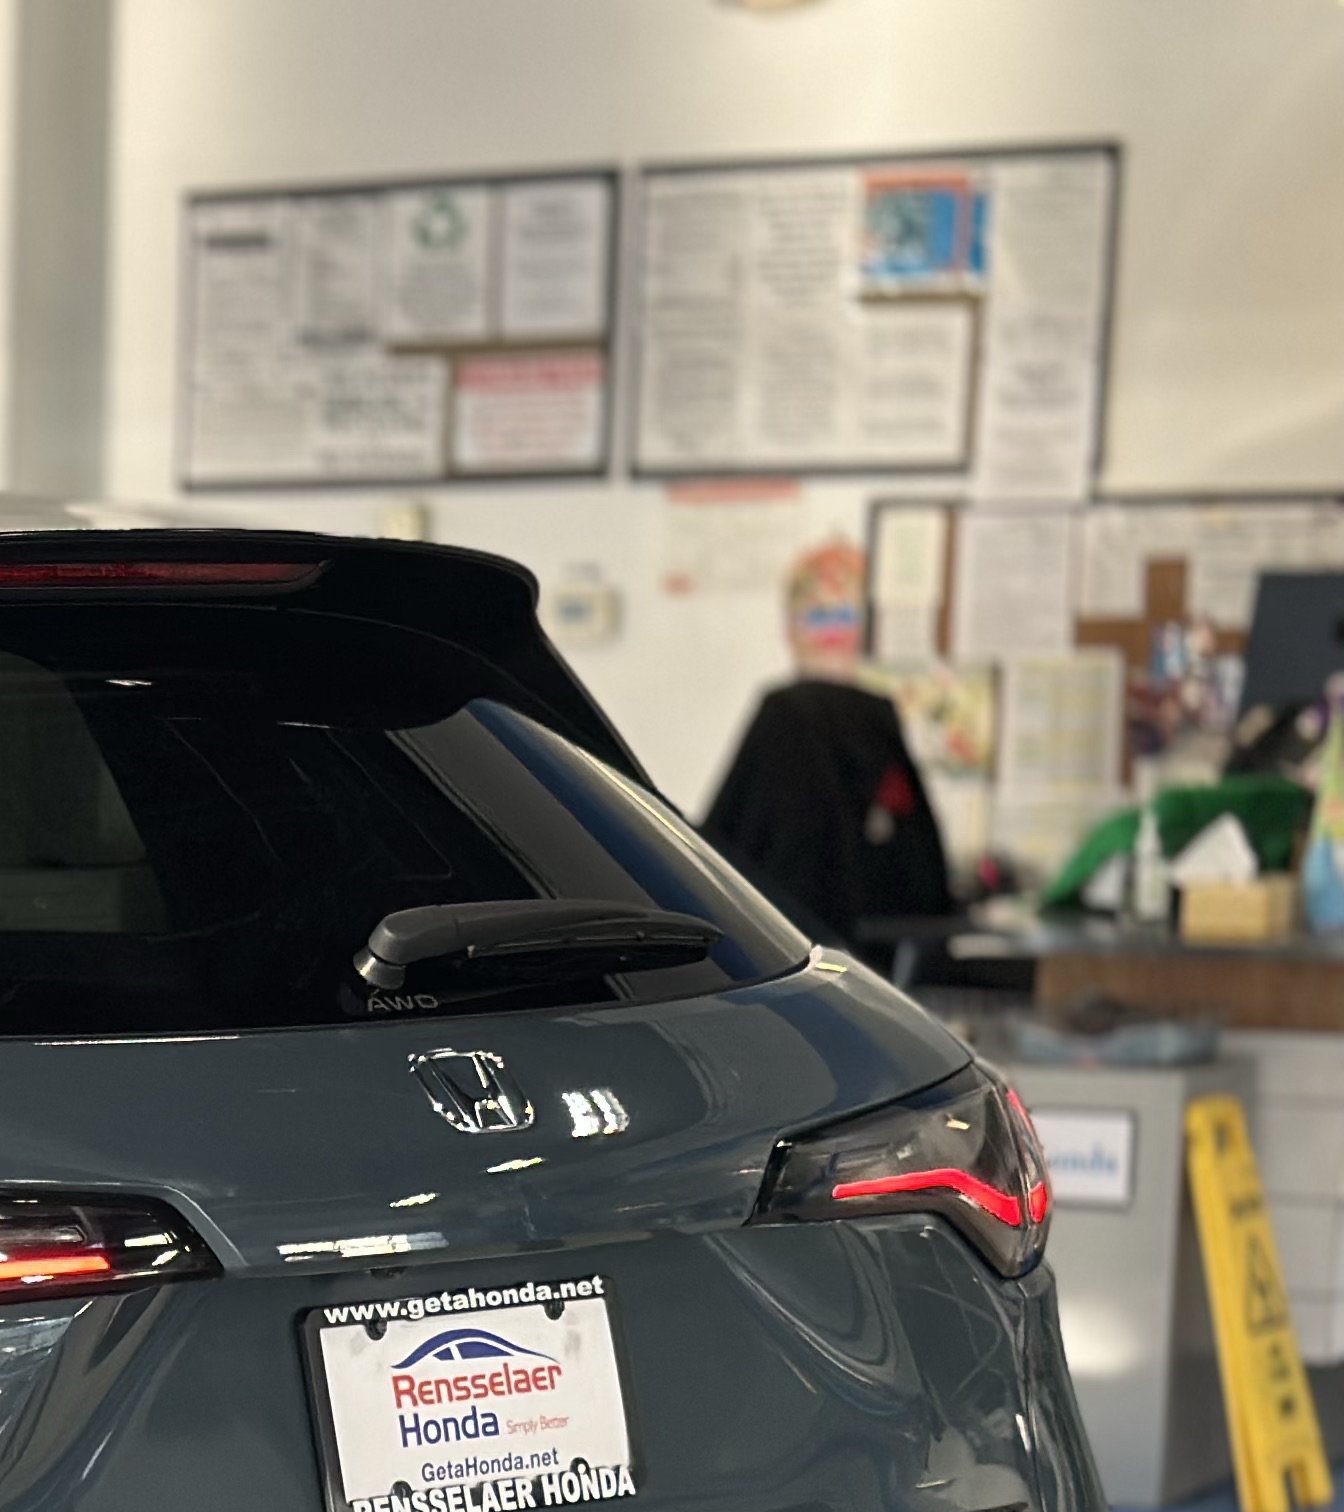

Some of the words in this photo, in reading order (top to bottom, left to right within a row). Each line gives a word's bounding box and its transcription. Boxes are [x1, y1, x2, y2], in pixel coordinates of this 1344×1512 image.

[324, 1276, 604, 1324] www.getahonda.net
[391, 1362, 563, 1409] Rensselaer
[398, 1405, 500, 1448] Honda
[421, 1447, 560, 1483] GetaHonda.net
[541, 1463, 637, 1506] HONDA
